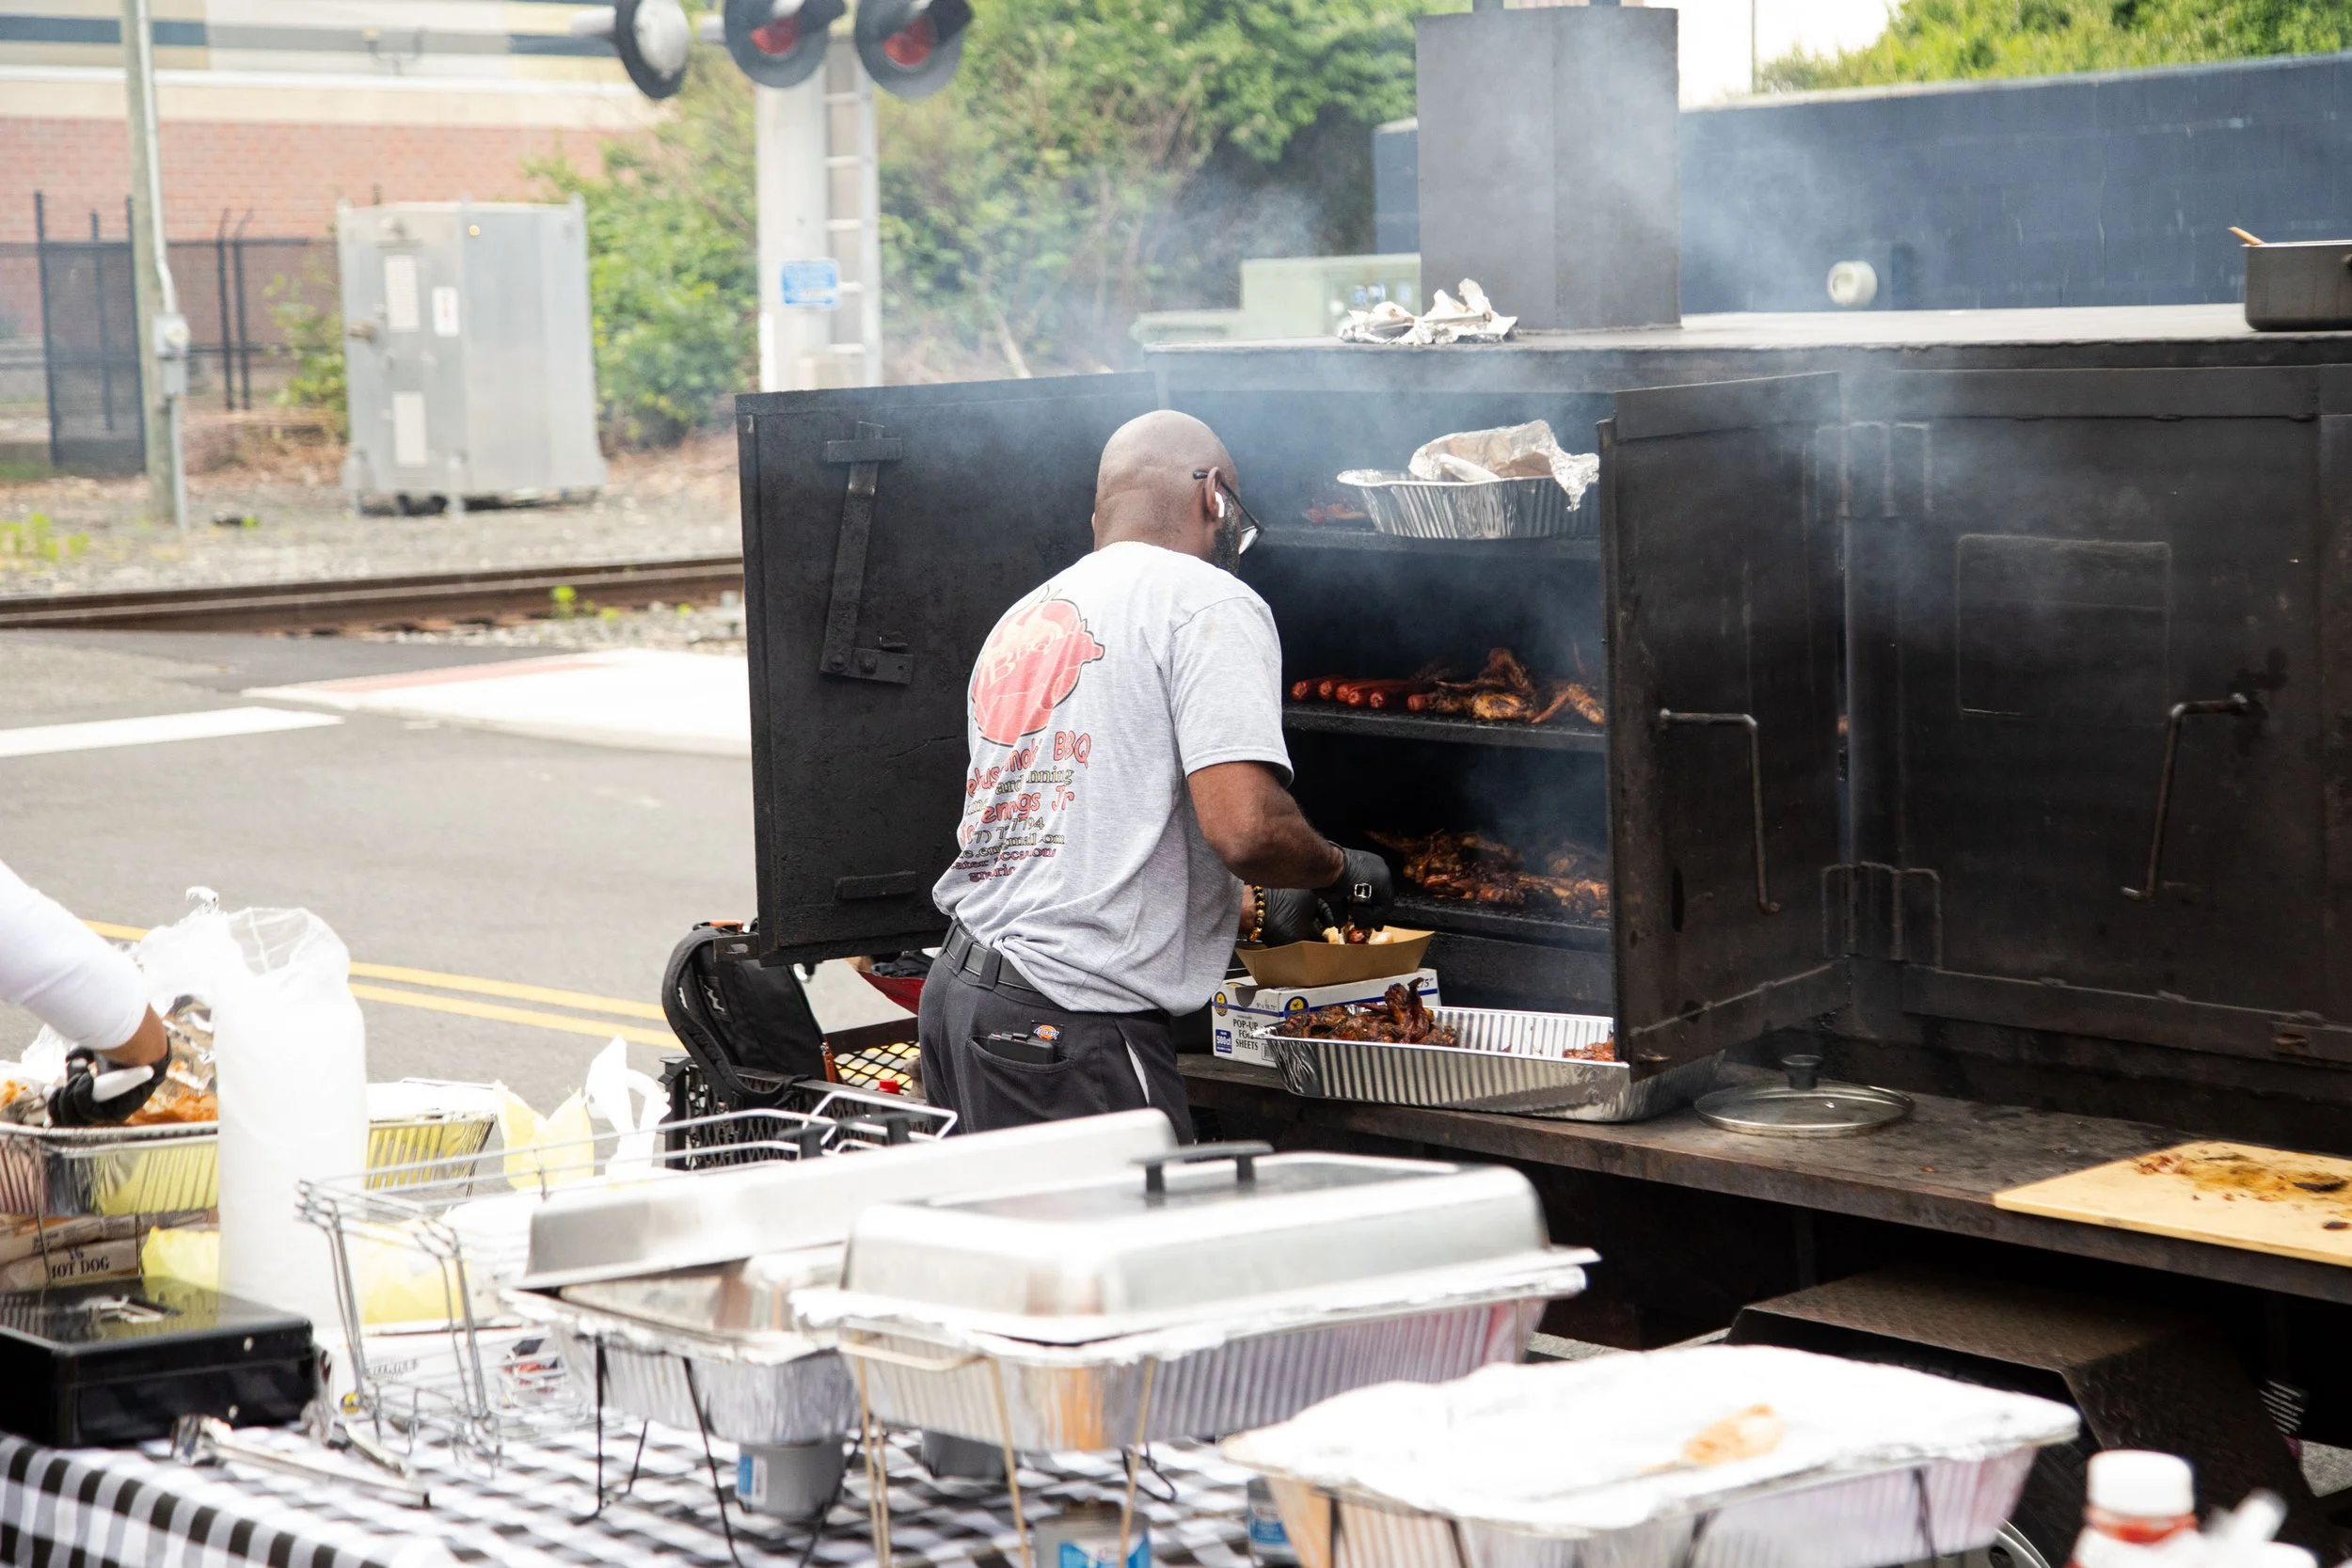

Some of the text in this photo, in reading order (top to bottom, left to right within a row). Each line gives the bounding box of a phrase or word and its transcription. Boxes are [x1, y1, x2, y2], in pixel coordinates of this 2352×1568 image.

[1053, 730, 1091, 768] BBQ
[1050, 784, 1075, 812] Jr
[1232, 1018, 1259, 1032] POP-UP
[1235, 1038, 1259, 1051] SHEETS
[80, 1255, 110, 1275] DOG
